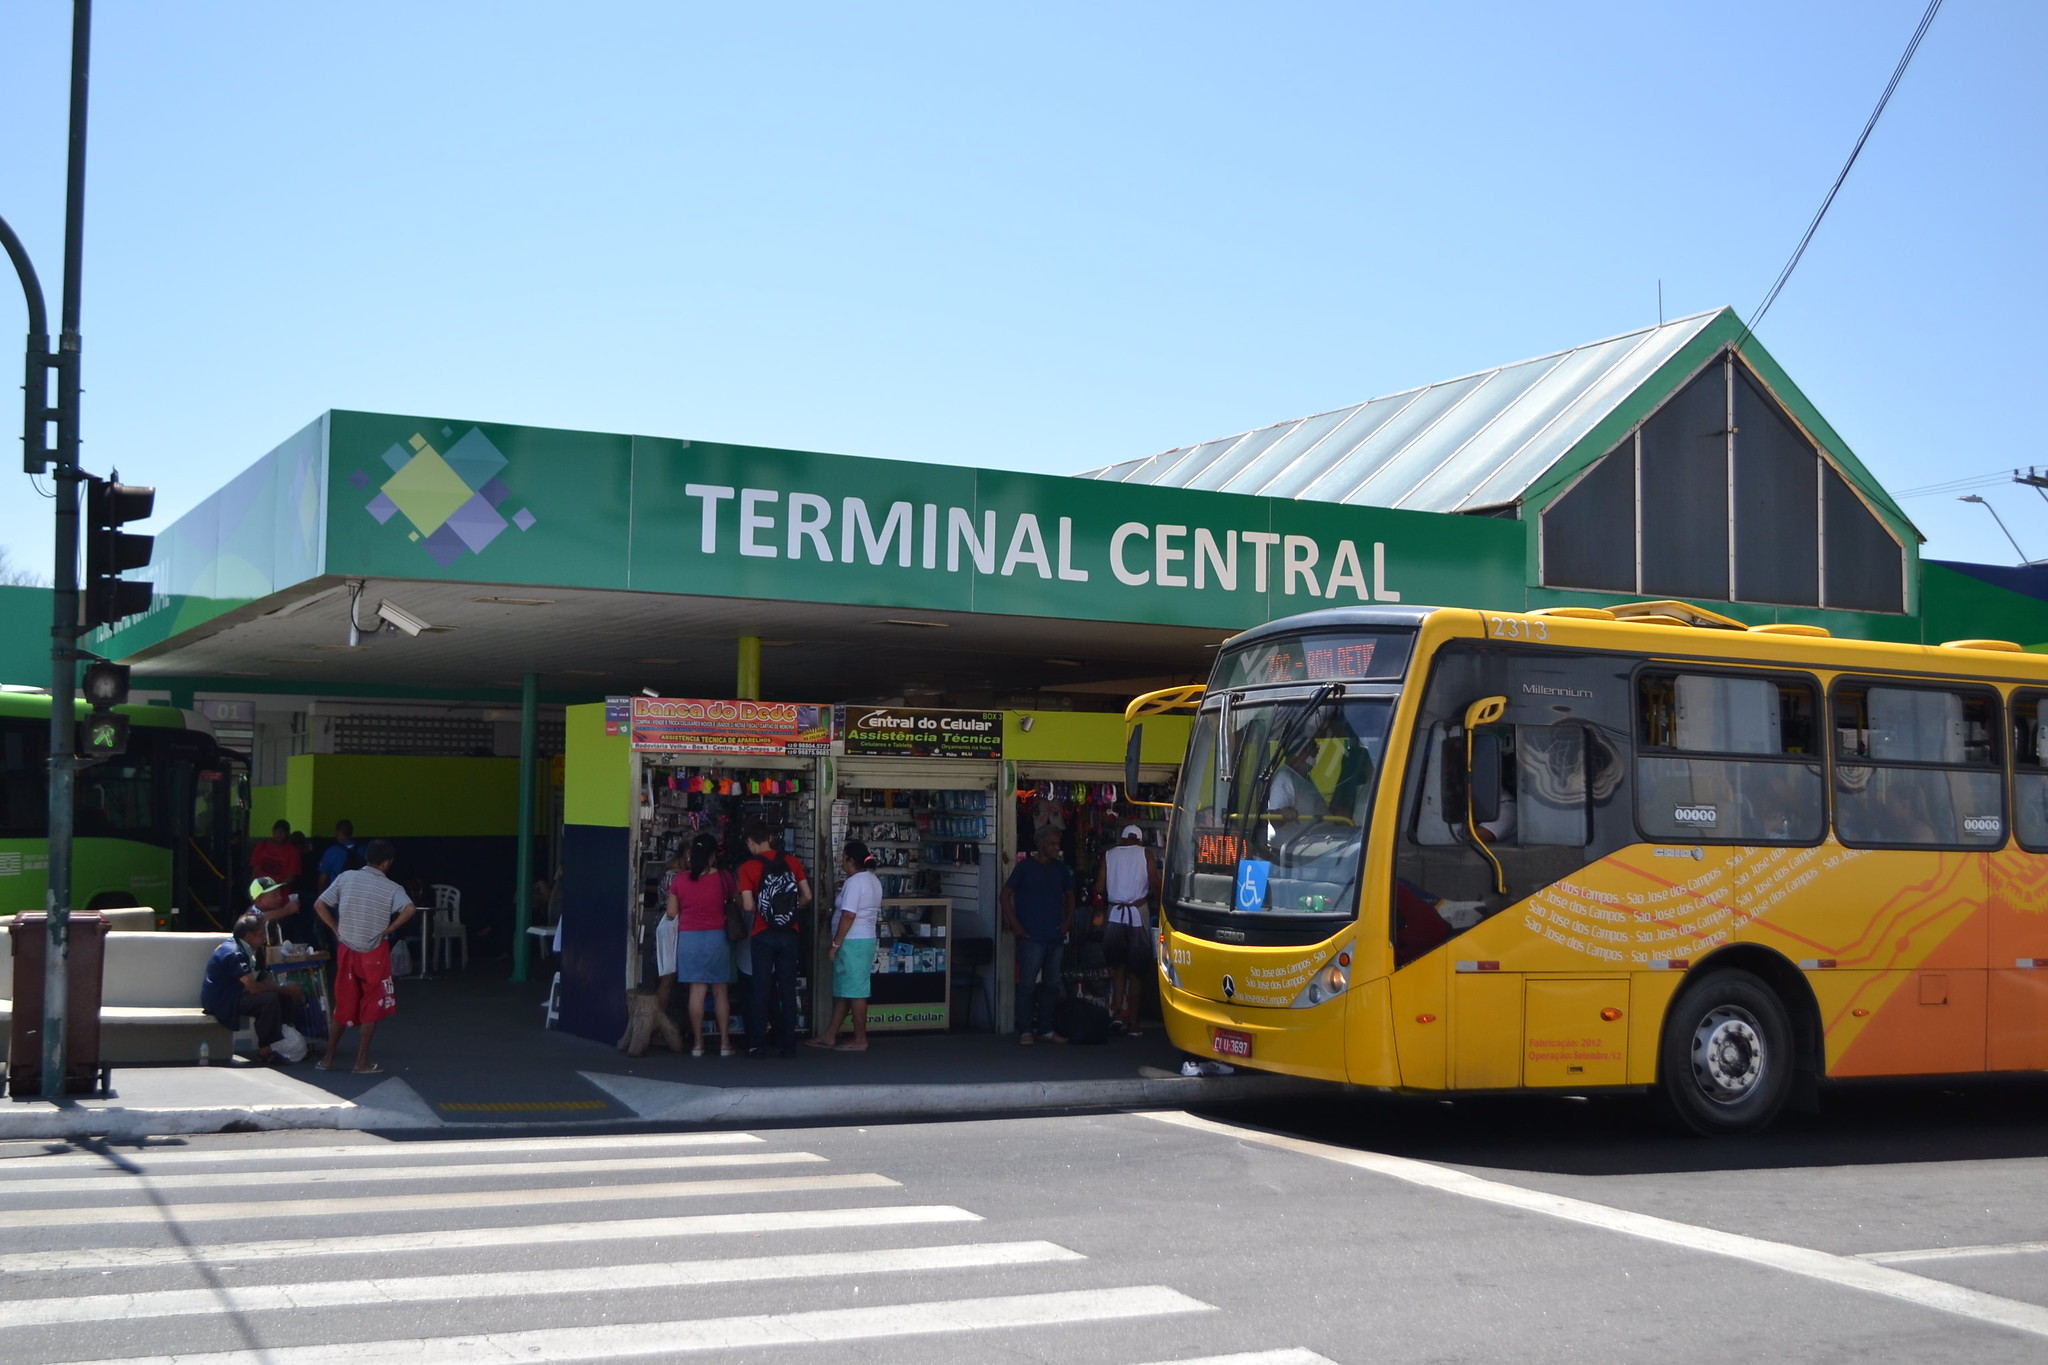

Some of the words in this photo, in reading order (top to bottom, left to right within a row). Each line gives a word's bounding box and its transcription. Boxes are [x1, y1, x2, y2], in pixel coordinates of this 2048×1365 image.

[685, 483, 1089, 582] TERMINAL
[1109, 521, 1400, 602] CENTRAL
[1491, 616, 1549, 640] 2313
[1522, 684, 1594, 698] Millennium
[217, 703, 239, 719] 01
[634, 698, 705, 719] Banca
[707, 701, 737, 720] do
[740, 702, 798, 722] Dedé
[858, 709, 915, 729] Central
[917, 717, 938, 730] do
[940, 718, 993, 731] Celular
[660, 734, 701, 743] ASSISTÊNCIA
[701, 735, 727, 744] TÉCNICA
[848, 729, 938, 743] Assistência
[942, 732, 1001, 744] Técnica
[1561, 880, 1579, 897] dos
[1581, 886, 1619, 904] Campos
[1670, 884, 1687, 898] dos
[1687, 868, 1722, 891] Campos
[1569, 899, 1587, 915] dos
[1590, 904, 1626, 923] Campos
[1677, 901, 1693, 916] dos
[1694, 887, 1729, 909] Campos
[1571, 917, 1589, 935] dos
[1591, 925, 1629, 944] Campos
[1679, 920, 1696, 935] dos
[1696, 905, 1731, 928] Campos
[1773, 864, 1790, 880] dos
[1567, 934, 1585, 951] dos
[1586, 942, 1624, 962] Campos
[1674, 942, 1691, 957] dos
[1691, 929, 1727, 951] Campos
[1771, 889, 1787, 905] dos
[1786, 868, 1819, 893] Campos
[1173, 948, 1192, 965] 2313
[1276, 965, 1287, 977] dos
[1288, 958, 1311, 975] Campos
[1271, 978, 1282, 990] dos
[1282, 975, 1306, 989] Campos
[888, 1013, 902, 1023] do
[905, 1011, 944, 1023] Celular
[1528, 1038, 1578, 1049] Fabricação:
[1581, 1038, 1602, 1048] 2012
[1528, 1050, 1571, 1062] Operação:
